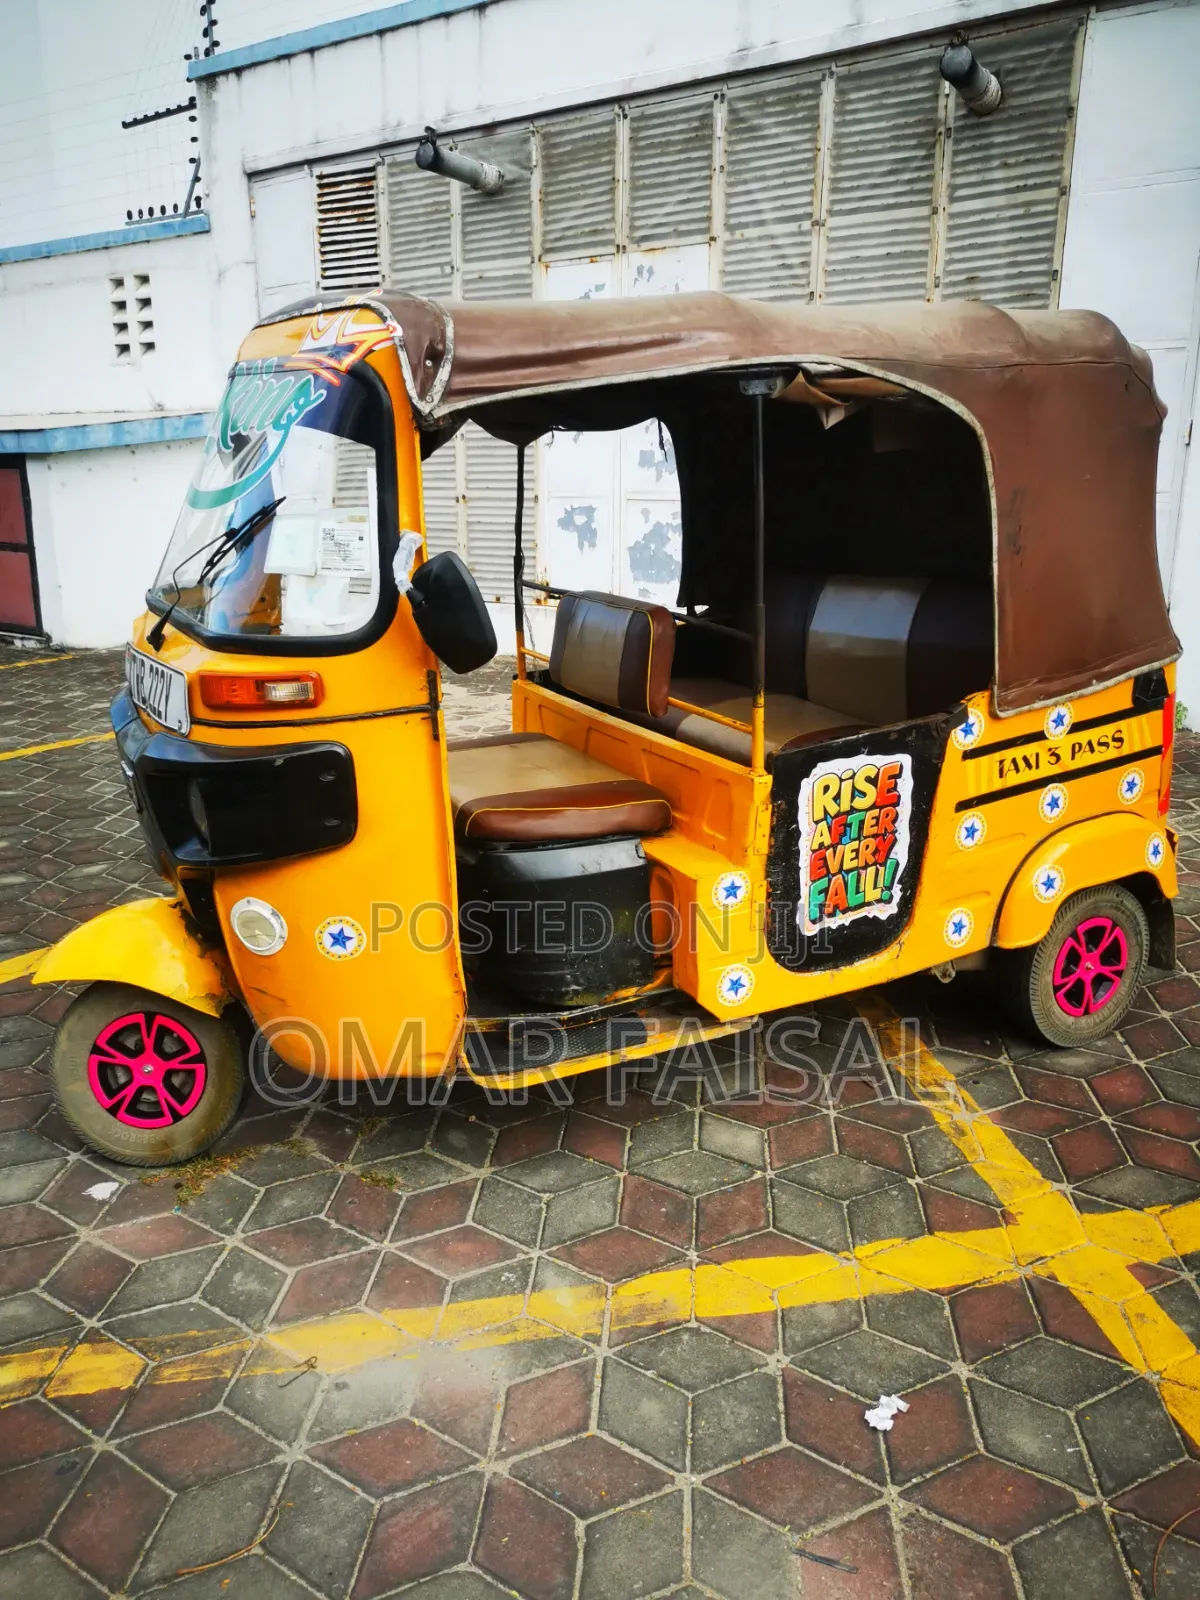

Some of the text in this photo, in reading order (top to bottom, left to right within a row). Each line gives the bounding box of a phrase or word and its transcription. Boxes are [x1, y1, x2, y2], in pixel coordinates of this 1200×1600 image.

[148, 664, 172, 723] 222Y
[996, 729, 1125, 779] TAXI 3 PASS
[810, 806, 899, 850] AFTER
[809, 834, 898, 881] EVERY
[809, 858, 900, 924] FALL!
